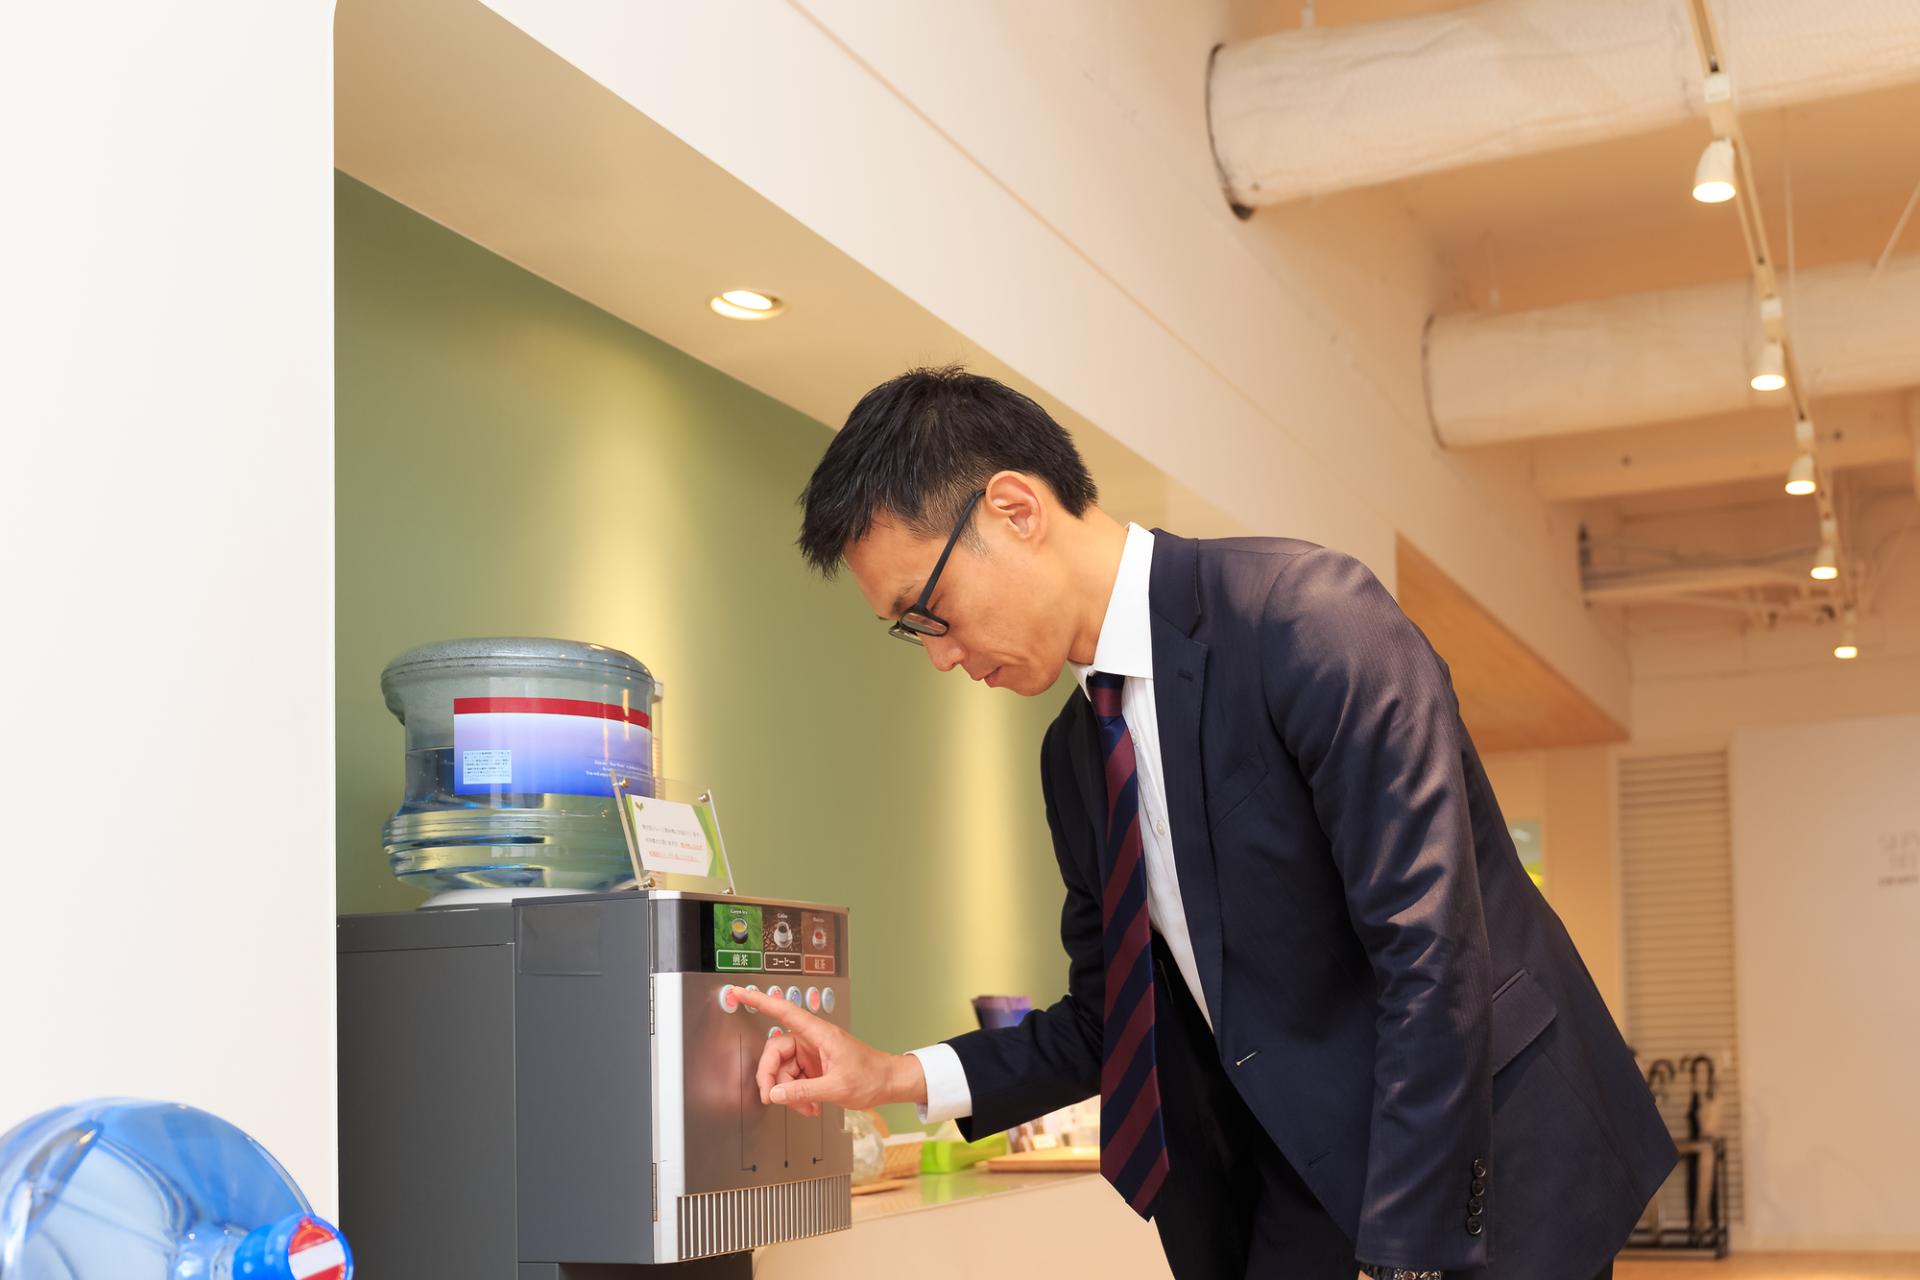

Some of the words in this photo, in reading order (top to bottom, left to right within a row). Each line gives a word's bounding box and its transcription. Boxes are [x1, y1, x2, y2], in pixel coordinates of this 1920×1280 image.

[733, 954, 748, 966] 煎茶
[773, 957, 795, 967] コーヒー
